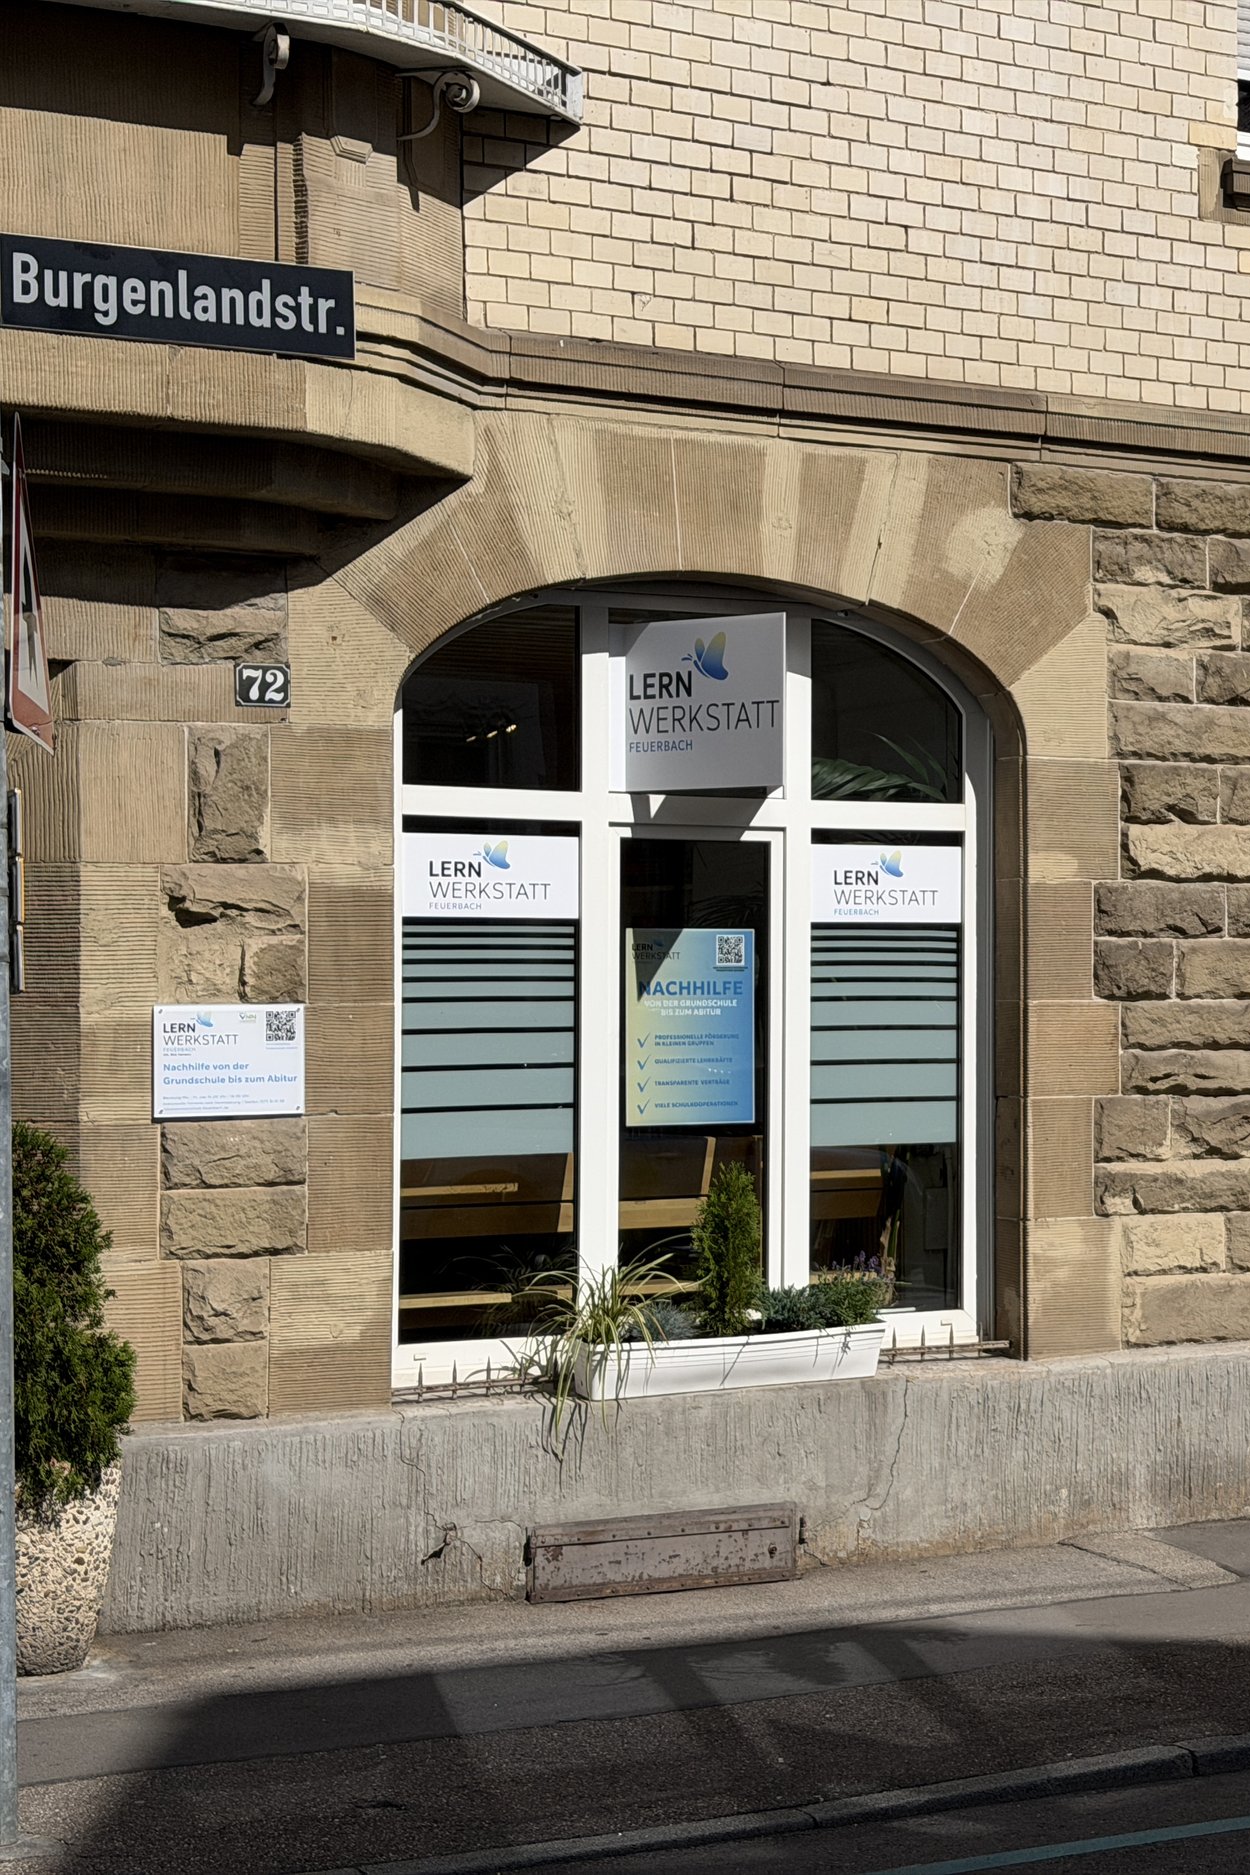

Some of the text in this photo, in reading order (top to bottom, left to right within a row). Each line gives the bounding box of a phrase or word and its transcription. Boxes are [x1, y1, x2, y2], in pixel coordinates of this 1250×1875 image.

[12, 251, 346, 336] Burgenlandstr.
[242, 668, 285, 702] 72
[629, 670, 692, 700] LERN
[629, 700, 780, 735] WERKSTATT
[629, 739, 693, 753] FEUERBACH
[429, 861, 482, 878] LERN
[834, 870, 879, 886] LERN
[429, 881, 551, 900] WERKSTATT
[834, 889, 938, 906] WERKSTATT
[429, 902, 482, 910] FEUERBACH
[834, 908, 879, 916] FEUERBACH
[632, 943, 653, 951] LERN
[632, 951, 680, 960] WERKSTATT
[640, 981, 743, 996] NACHHILFE
[680, 999, 738, 1007] GRUNDSCHULE
[693, 1008, 721, 1016] ABITUR
[163, 1023, 196, 1033] LERN
[163, 1034, 238, 1046] WERKSTATT
[163, 1063, 211, 1072] Nachhilfe
[233, 1062, 249, 1070] der
[163, 1076, 226, 1085] Grundschule
[228, 1075, 243, 1084] bis
[267, 1074, 297, 1083] Abitur
